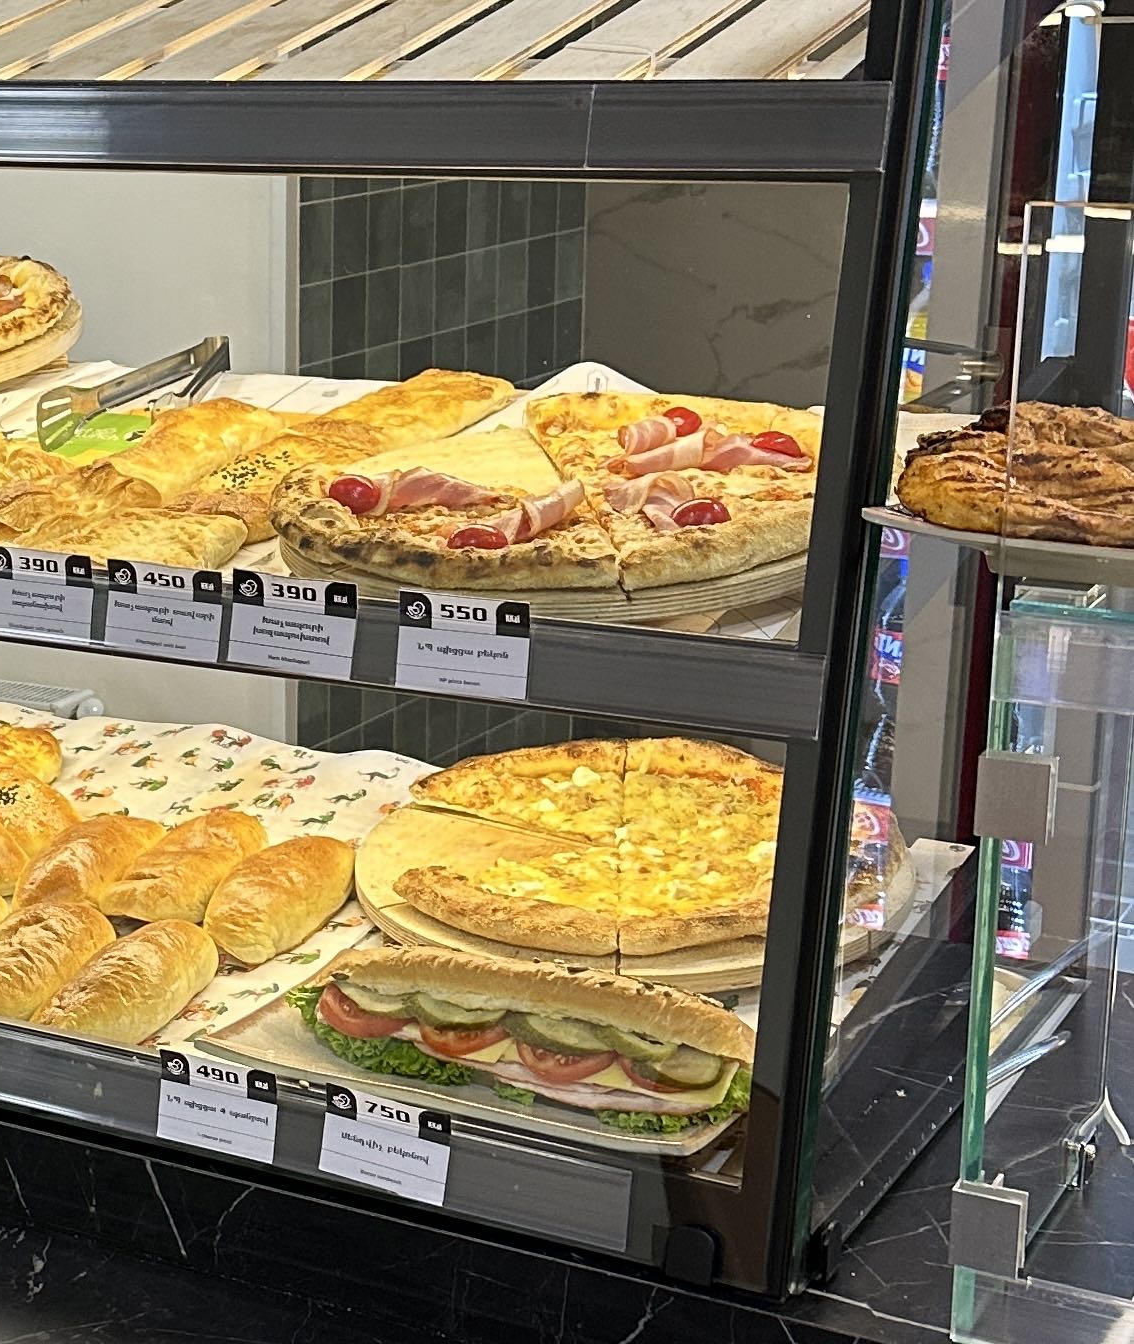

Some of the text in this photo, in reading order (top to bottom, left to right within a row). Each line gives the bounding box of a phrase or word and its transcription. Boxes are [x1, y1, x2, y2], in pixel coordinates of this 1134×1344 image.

[19, 556, 59, 573] 390
[143, 571, 185, 589] 450
[271, 583, 317, 602] 390
[440, 604, 487, 622] 550
[196, 1064, 239, 1085] 490
[364, 1100, 411, 1124] 750
